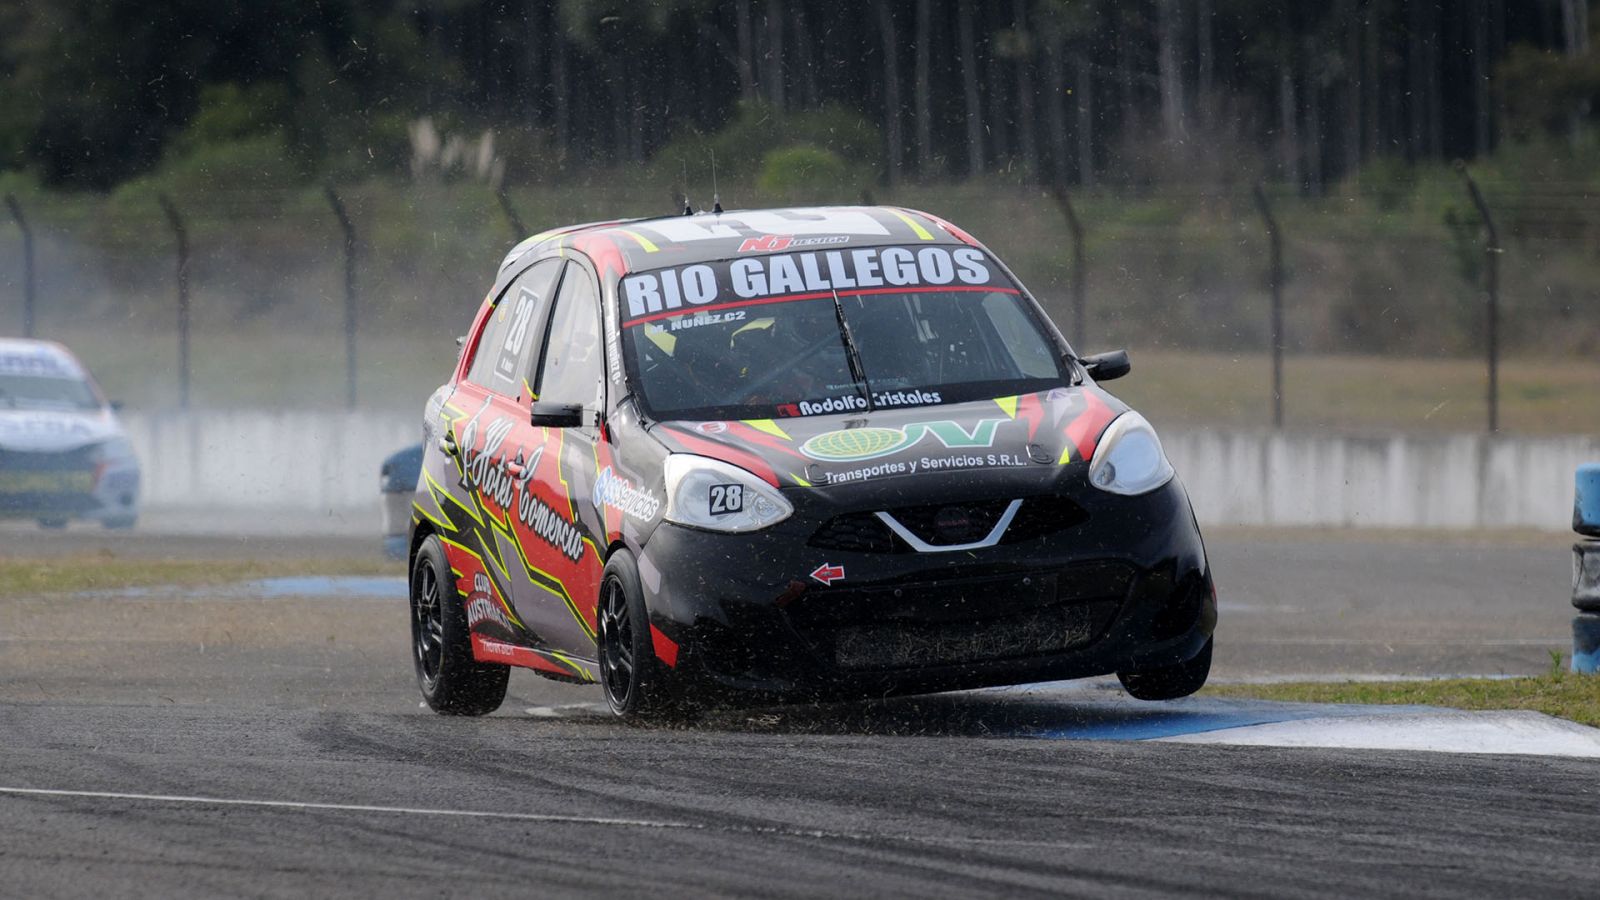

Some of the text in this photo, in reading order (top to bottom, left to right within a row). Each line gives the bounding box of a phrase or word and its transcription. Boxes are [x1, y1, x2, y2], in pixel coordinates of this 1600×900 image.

[624, 246, 991, 317] RIO GALLEGOS
[504, 295, 535, 356] 28
[800, 396, 867, 416] Rodolfo
[873, 390, 942, 407] Cristales
[460, 395, 584, 561] Hotel Comercio
[825, 455, 1027, 484] Transportes y Servicios S.R.L.
[711, 485, 742, 513] 28
